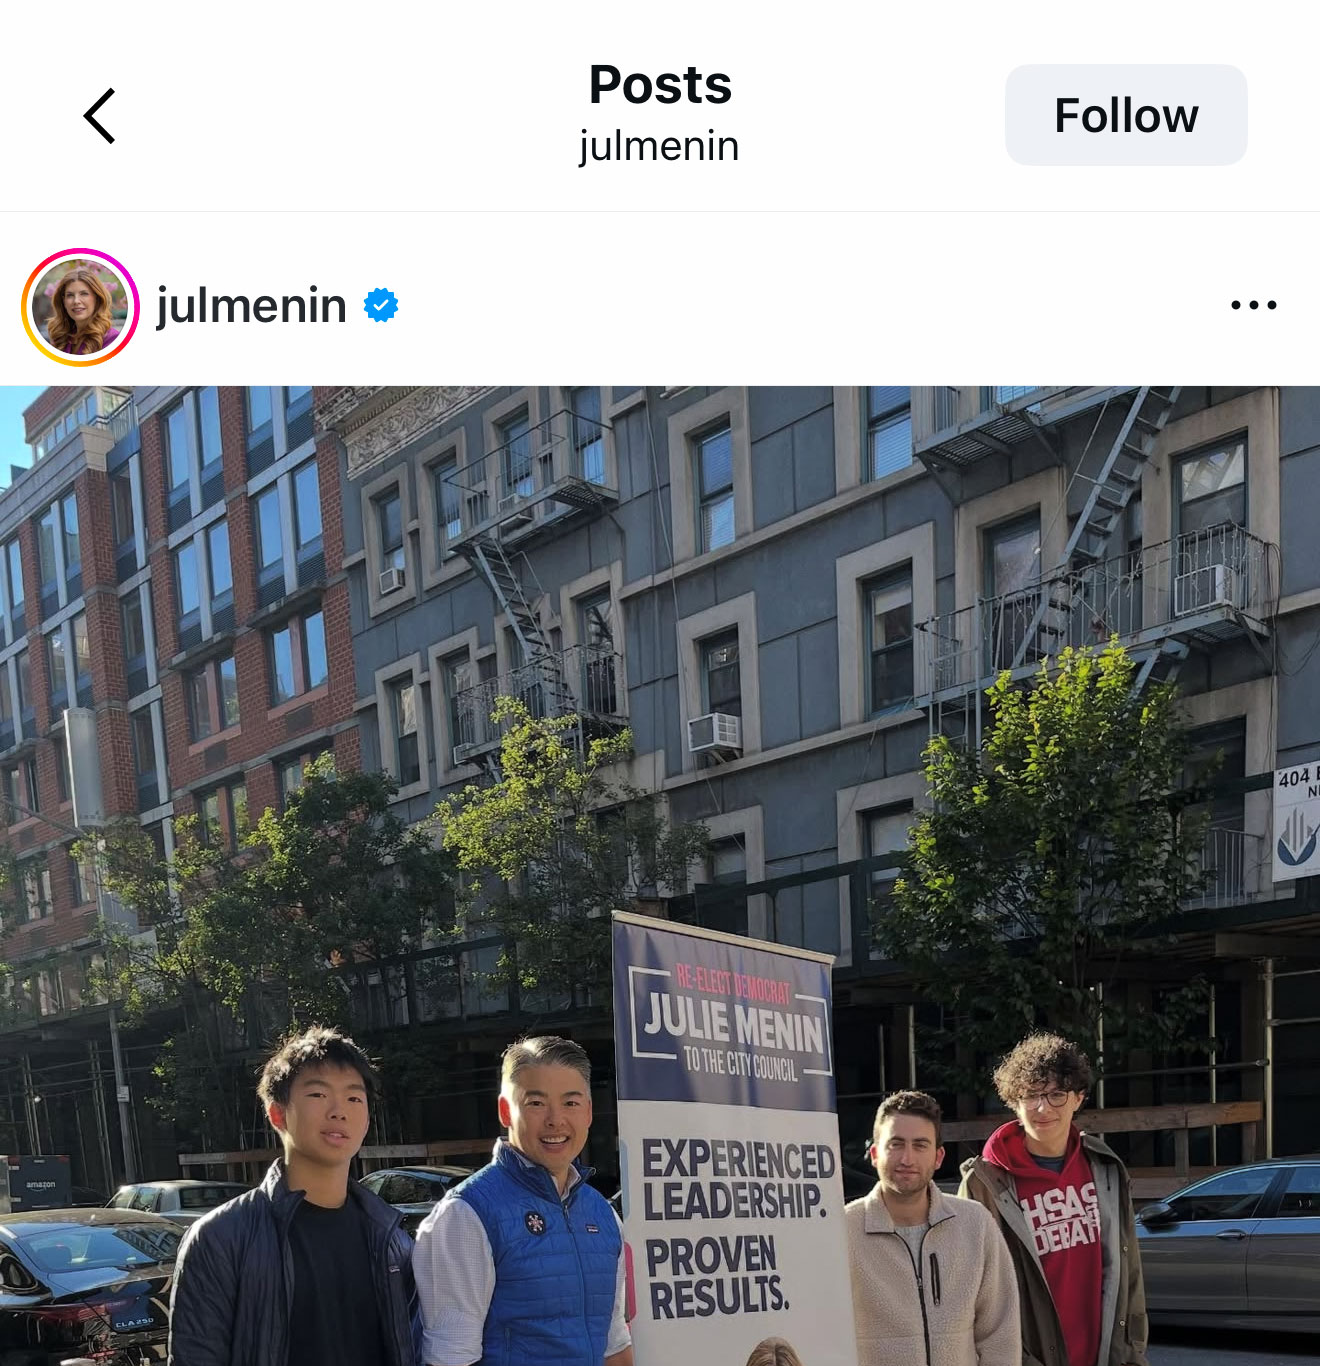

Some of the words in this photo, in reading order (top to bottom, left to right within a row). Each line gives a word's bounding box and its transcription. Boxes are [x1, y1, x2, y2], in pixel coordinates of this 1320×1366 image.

[1279, 768, 1310, 788] 404
[676, 962, 731, 997] RE-ELECT
[734, 972, 790, 1005] DEMOCRAT
[644, 992, 729, 1043] JULIE
[736, 1005, 824, 1054] MENIN
[683, 1045, 700, 1072] TO
[702, 1048, 725, 1075] THE
[727, 1050, 752, 1077] CITY
[753, 1055, 798, 1082] COUNCIL
[642, 1138, 835, 1179] EXPERIENCED
[26, 1181, 56, 1190] amazon
[644, 1181, 826, 1221] LEADERSHIP.
[1020, 1182, 1098, 1230] HSAS
[646, 1234, 776, 1278] PROVEN
[650, 1274, 790, 1320] RESULTS.
[116, 1320, 135, 1328] CLA
[136, 1317, 154, 1325] 250
